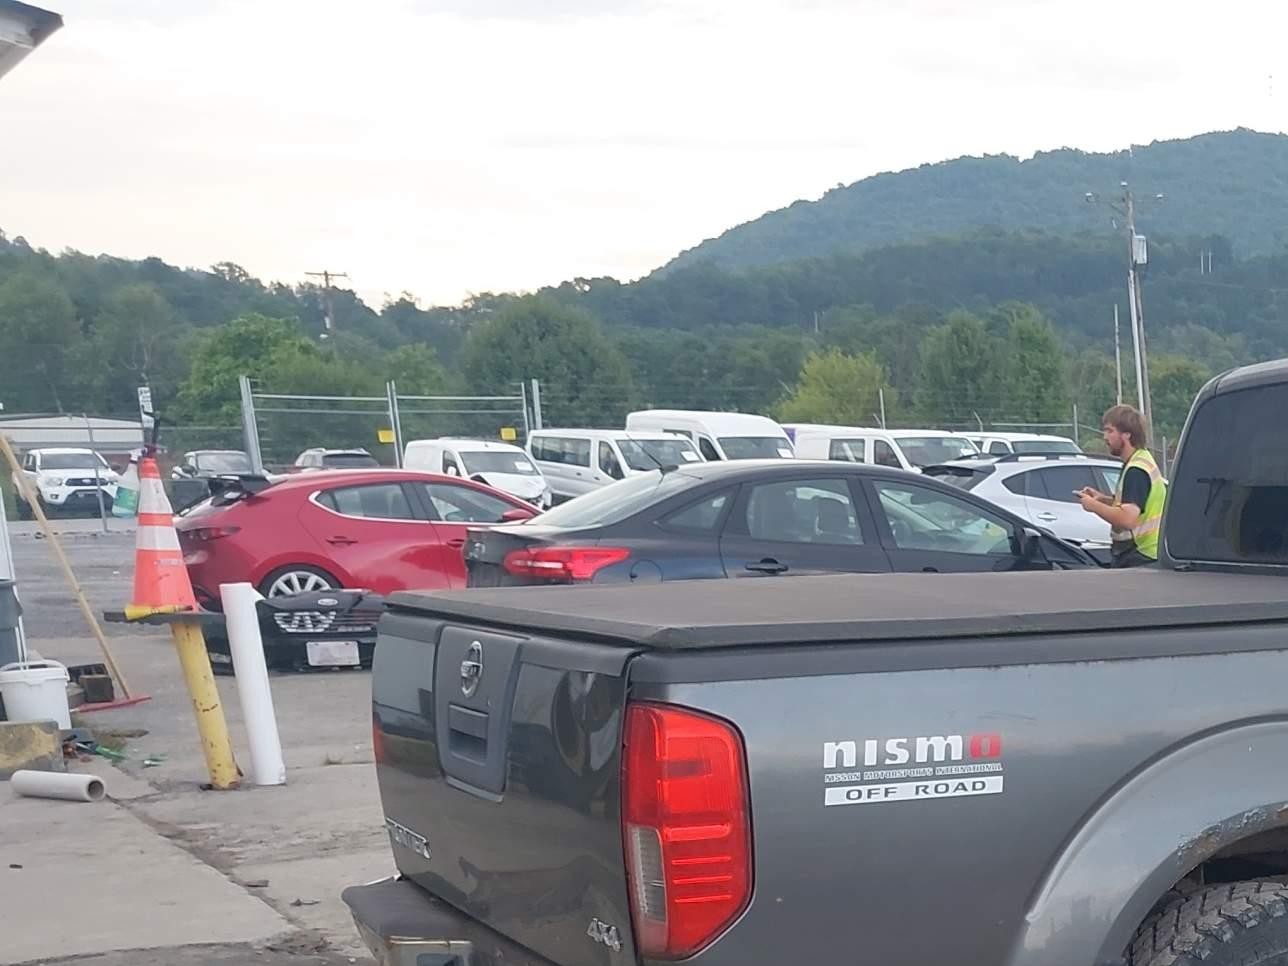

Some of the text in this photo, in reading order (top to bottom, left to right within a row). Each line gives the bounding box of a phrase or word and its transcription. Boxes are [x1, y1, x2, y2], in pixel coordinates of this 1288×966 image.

[823, 733, 1002, 769] nismo
[845, 780, 987, 801] OFF ROAD
